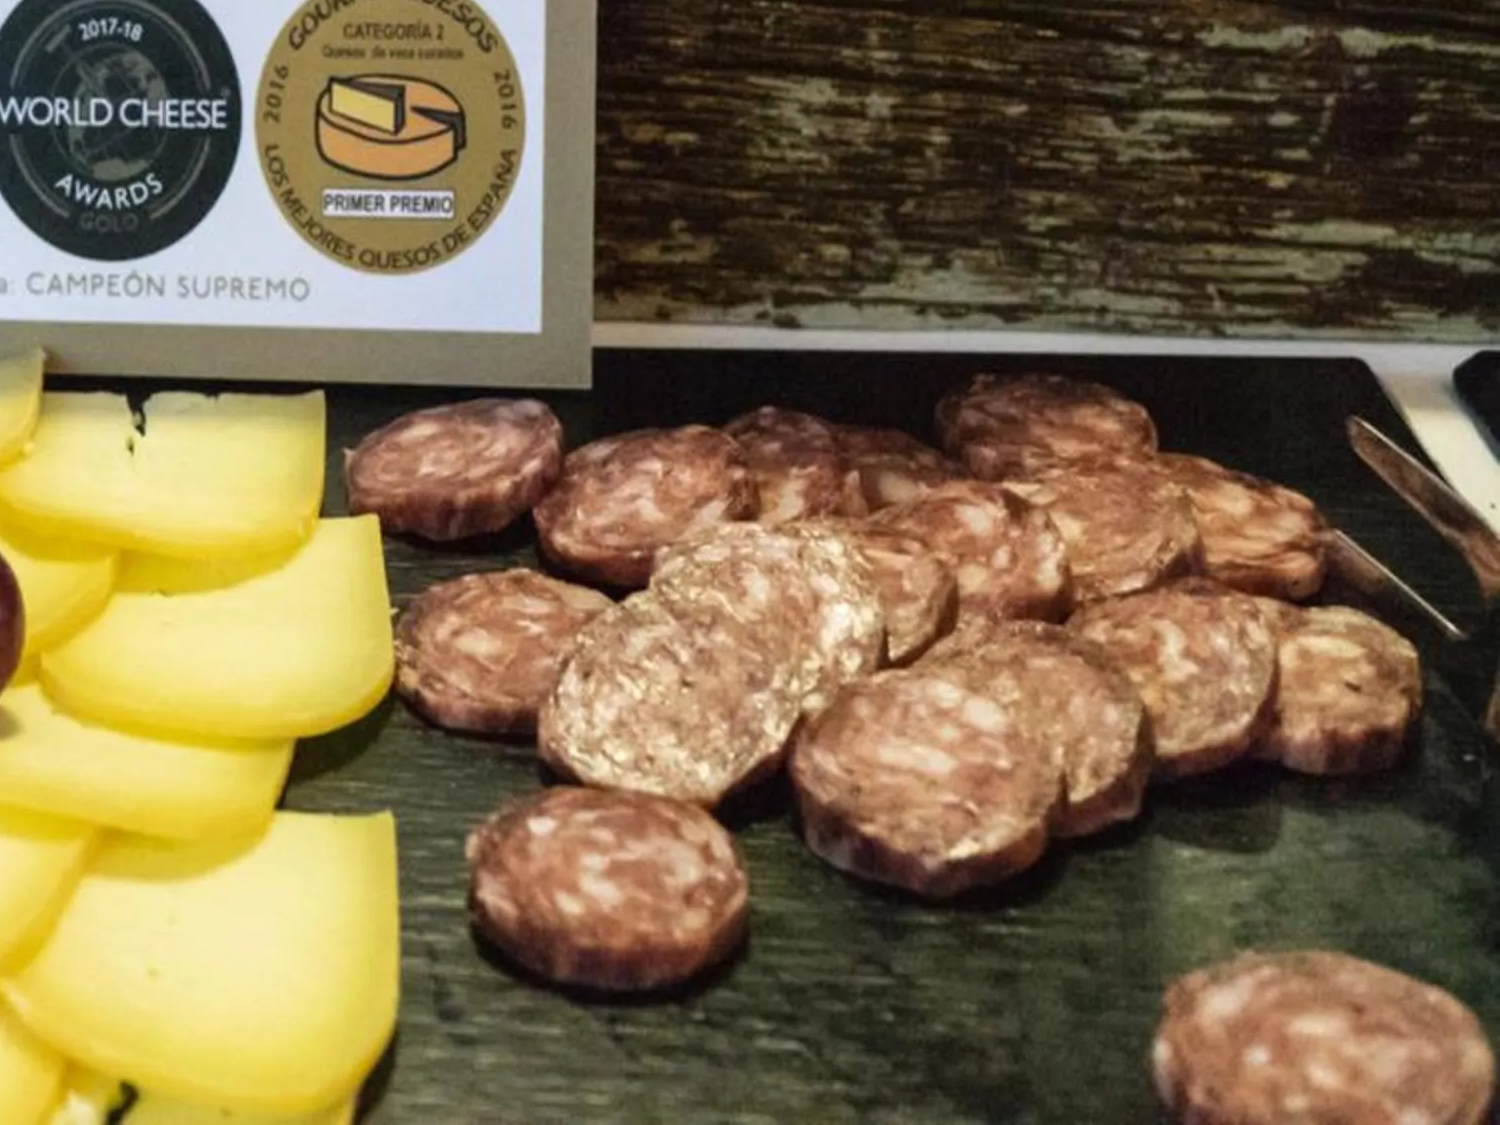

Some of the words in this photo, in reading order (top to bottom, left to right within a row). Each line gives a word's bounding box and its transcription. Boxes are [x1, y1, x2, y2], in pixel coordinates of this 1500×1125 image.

[78, 17, 143, 42] 2017-18
[264, 64, 288, 123] 2016
[494, 70, 517, 130] 2016
[119, 97, 228, 129] CHEESE
[55, 172, 163, 210] AWARDS
[265, 144, 288, 188] LOS
[281, 187, 354, 261] MEJORES
[358, 241, 442, 270] QUESOS
[441, 227, 470, 255] DE
[324, 193, 385, 212] PRIMER
[390, 193, 453, 213] PREMIO
[79, 212, 139, 232] GOLD
[26, 271, 166, 298] CAMPEÓN
[177, 275, 311, 303] SUPREMO
